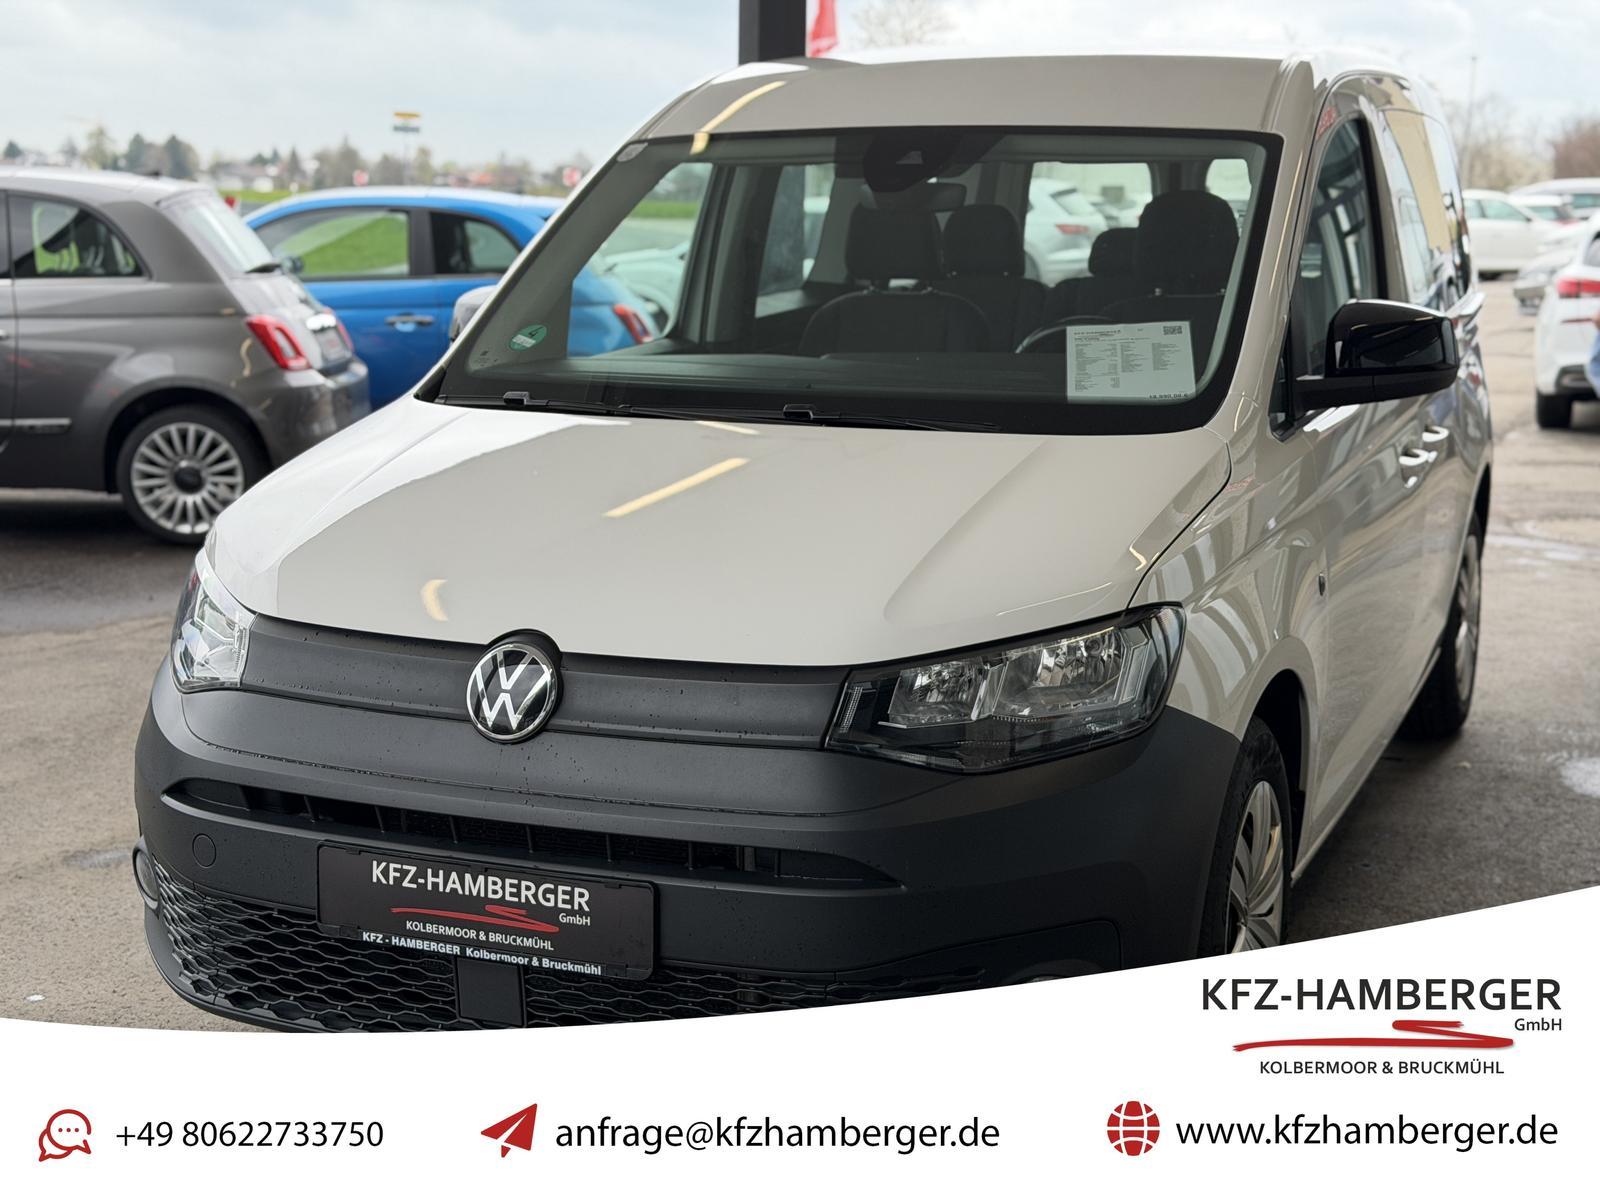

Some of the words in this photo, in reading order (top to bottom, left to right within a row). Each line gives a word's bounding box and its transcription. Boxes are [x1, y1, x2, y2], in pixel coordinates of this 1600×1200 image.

[472, 647, 551, 735] VW
[372, 860, 591, 912] KFZ-HAMBERGER
[406, 920, 477, 940] KOLBERMOOR
[478, 931, 487, 941] &
[488, 932, 554, 951] BRUCKMÜHL
[558, 912, 591, 926] GmbH
[362, 931, 384, 944] KFZ
[391, 935, 461, 955] HAMBERGER
[465, 947, 530, 965] Kolbermoor
[531, 957, 540, 967] &
[542, 958, 602, 976] Bruckmühl
